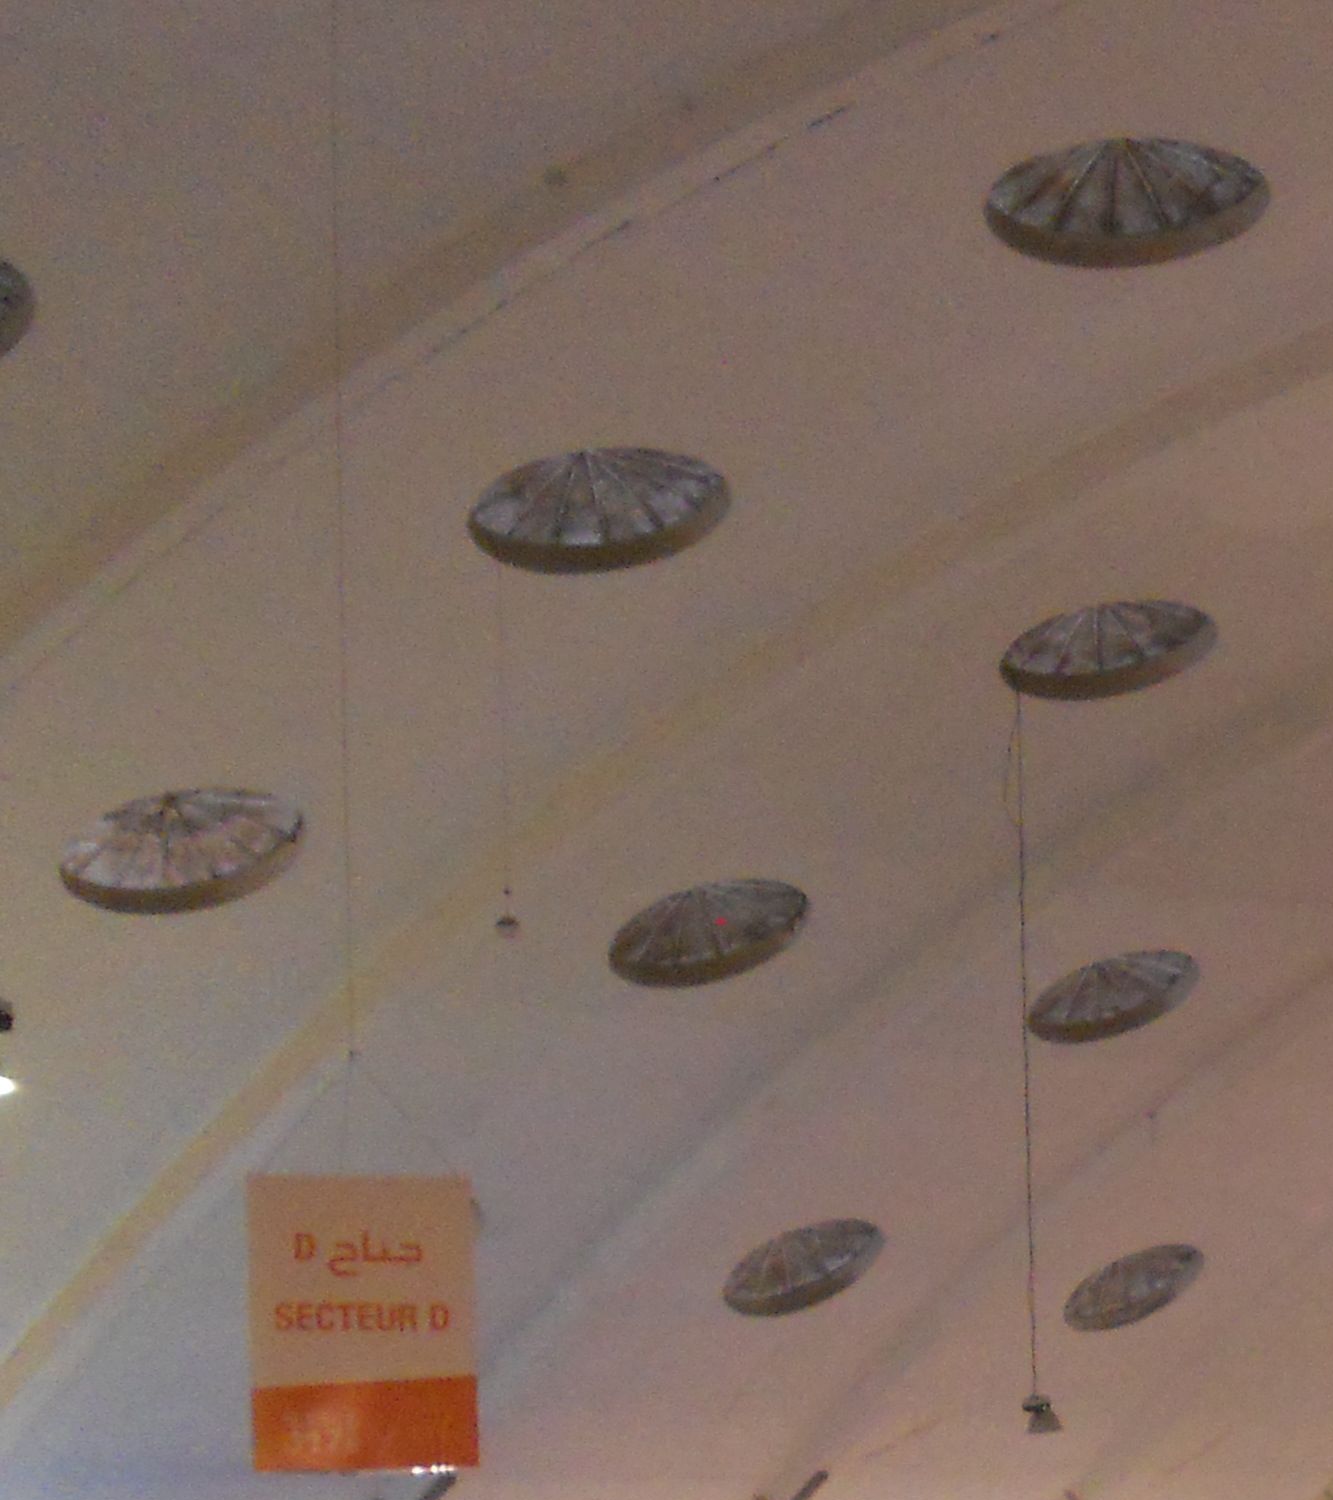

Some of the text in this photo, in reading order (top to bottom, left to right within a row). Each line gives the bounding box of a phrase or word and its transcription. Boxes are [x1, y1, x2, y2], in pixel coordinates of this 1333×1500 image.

[293, 1232, 316, 1261] D
[274, 1302, 450, 1332] SECTEUR D
